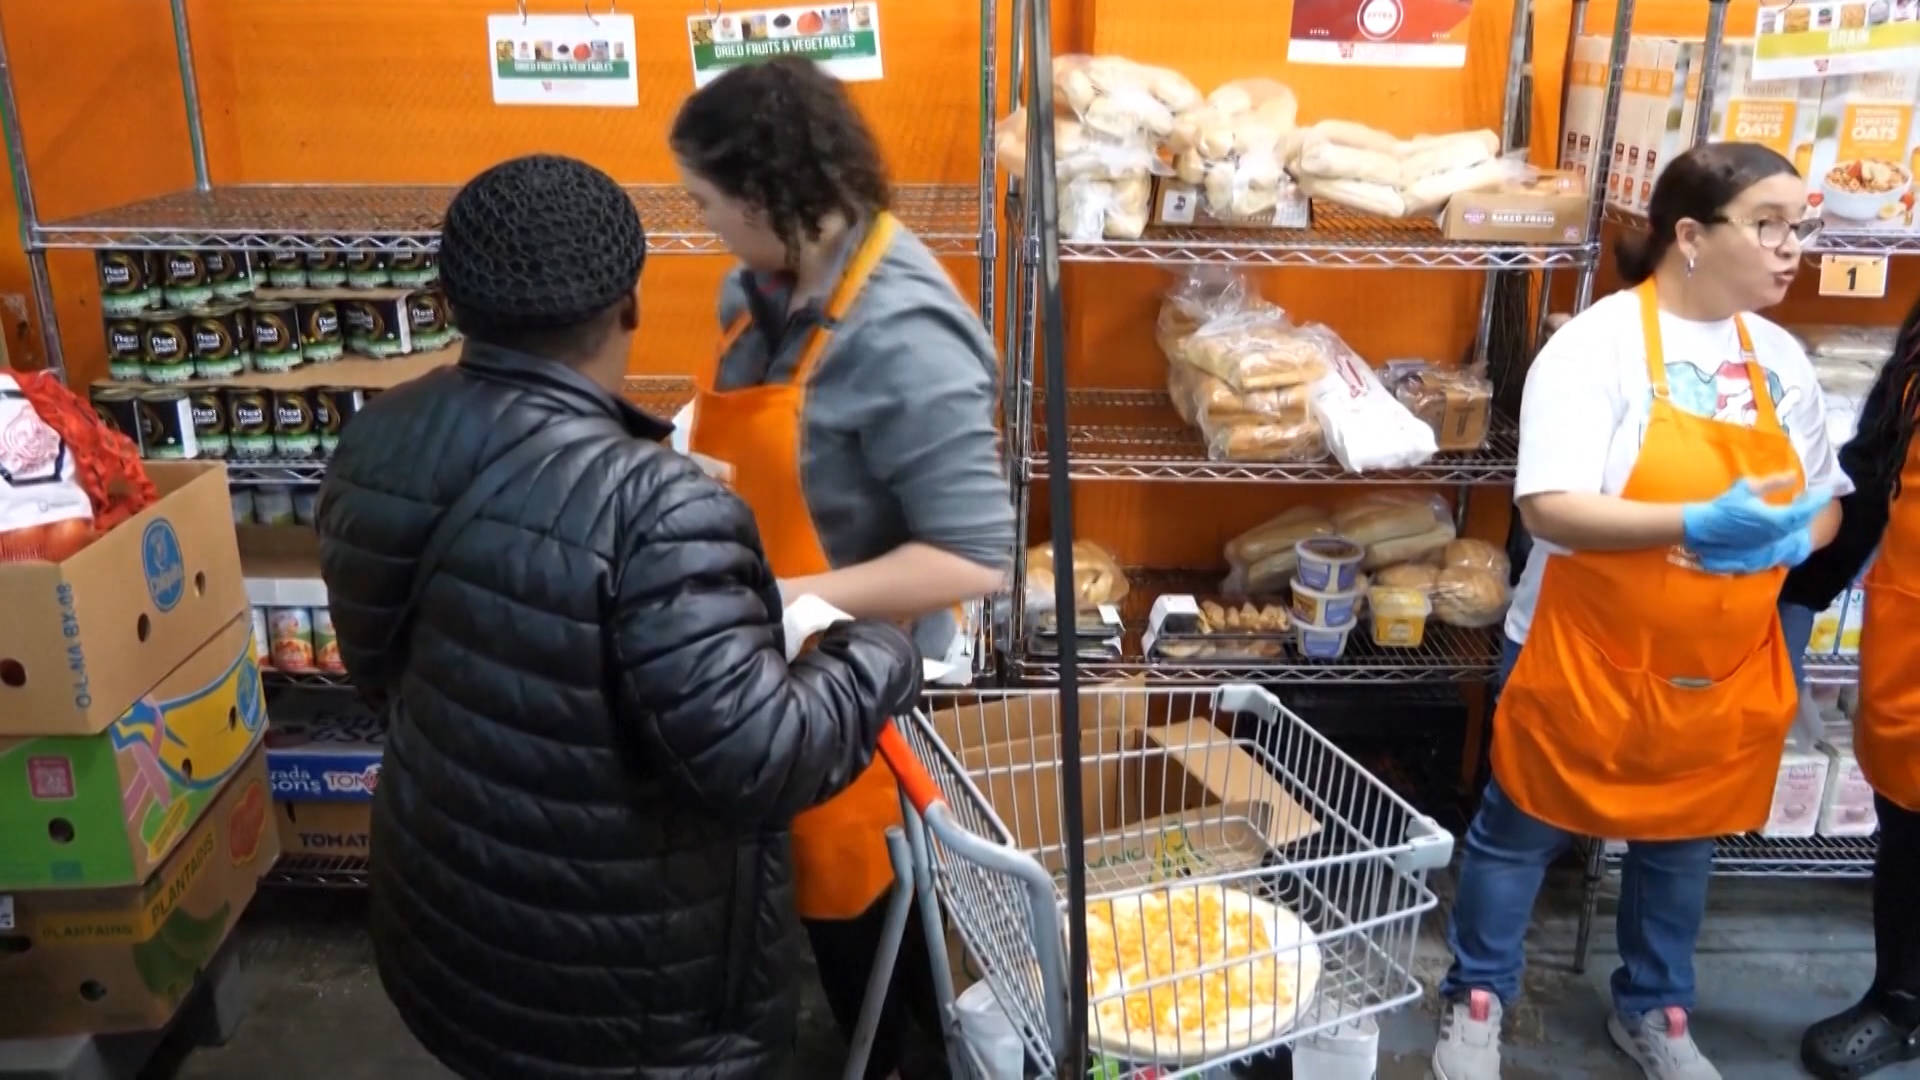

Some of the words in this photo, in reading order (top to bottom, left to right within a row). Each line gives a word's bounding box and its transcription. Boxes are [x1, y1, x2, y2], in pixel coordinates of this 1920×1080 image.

[714, 44, 744, 58] DRIED
[746, 41, 781, 56] FRUITS
[782, 41, 791, 52] &
[791, 34, 856, 53] VEGETABLES
[537, 62, 561, 72] FRUITS
[1735, 121, 1782, 138] OATS
[1851, 126, 1898, 141] OATS
[1847, 266, 1857, 290] 1
[151, 831, 215, 926] PLANTAINS
[42, 925, 133, 939] PLANTAINS
